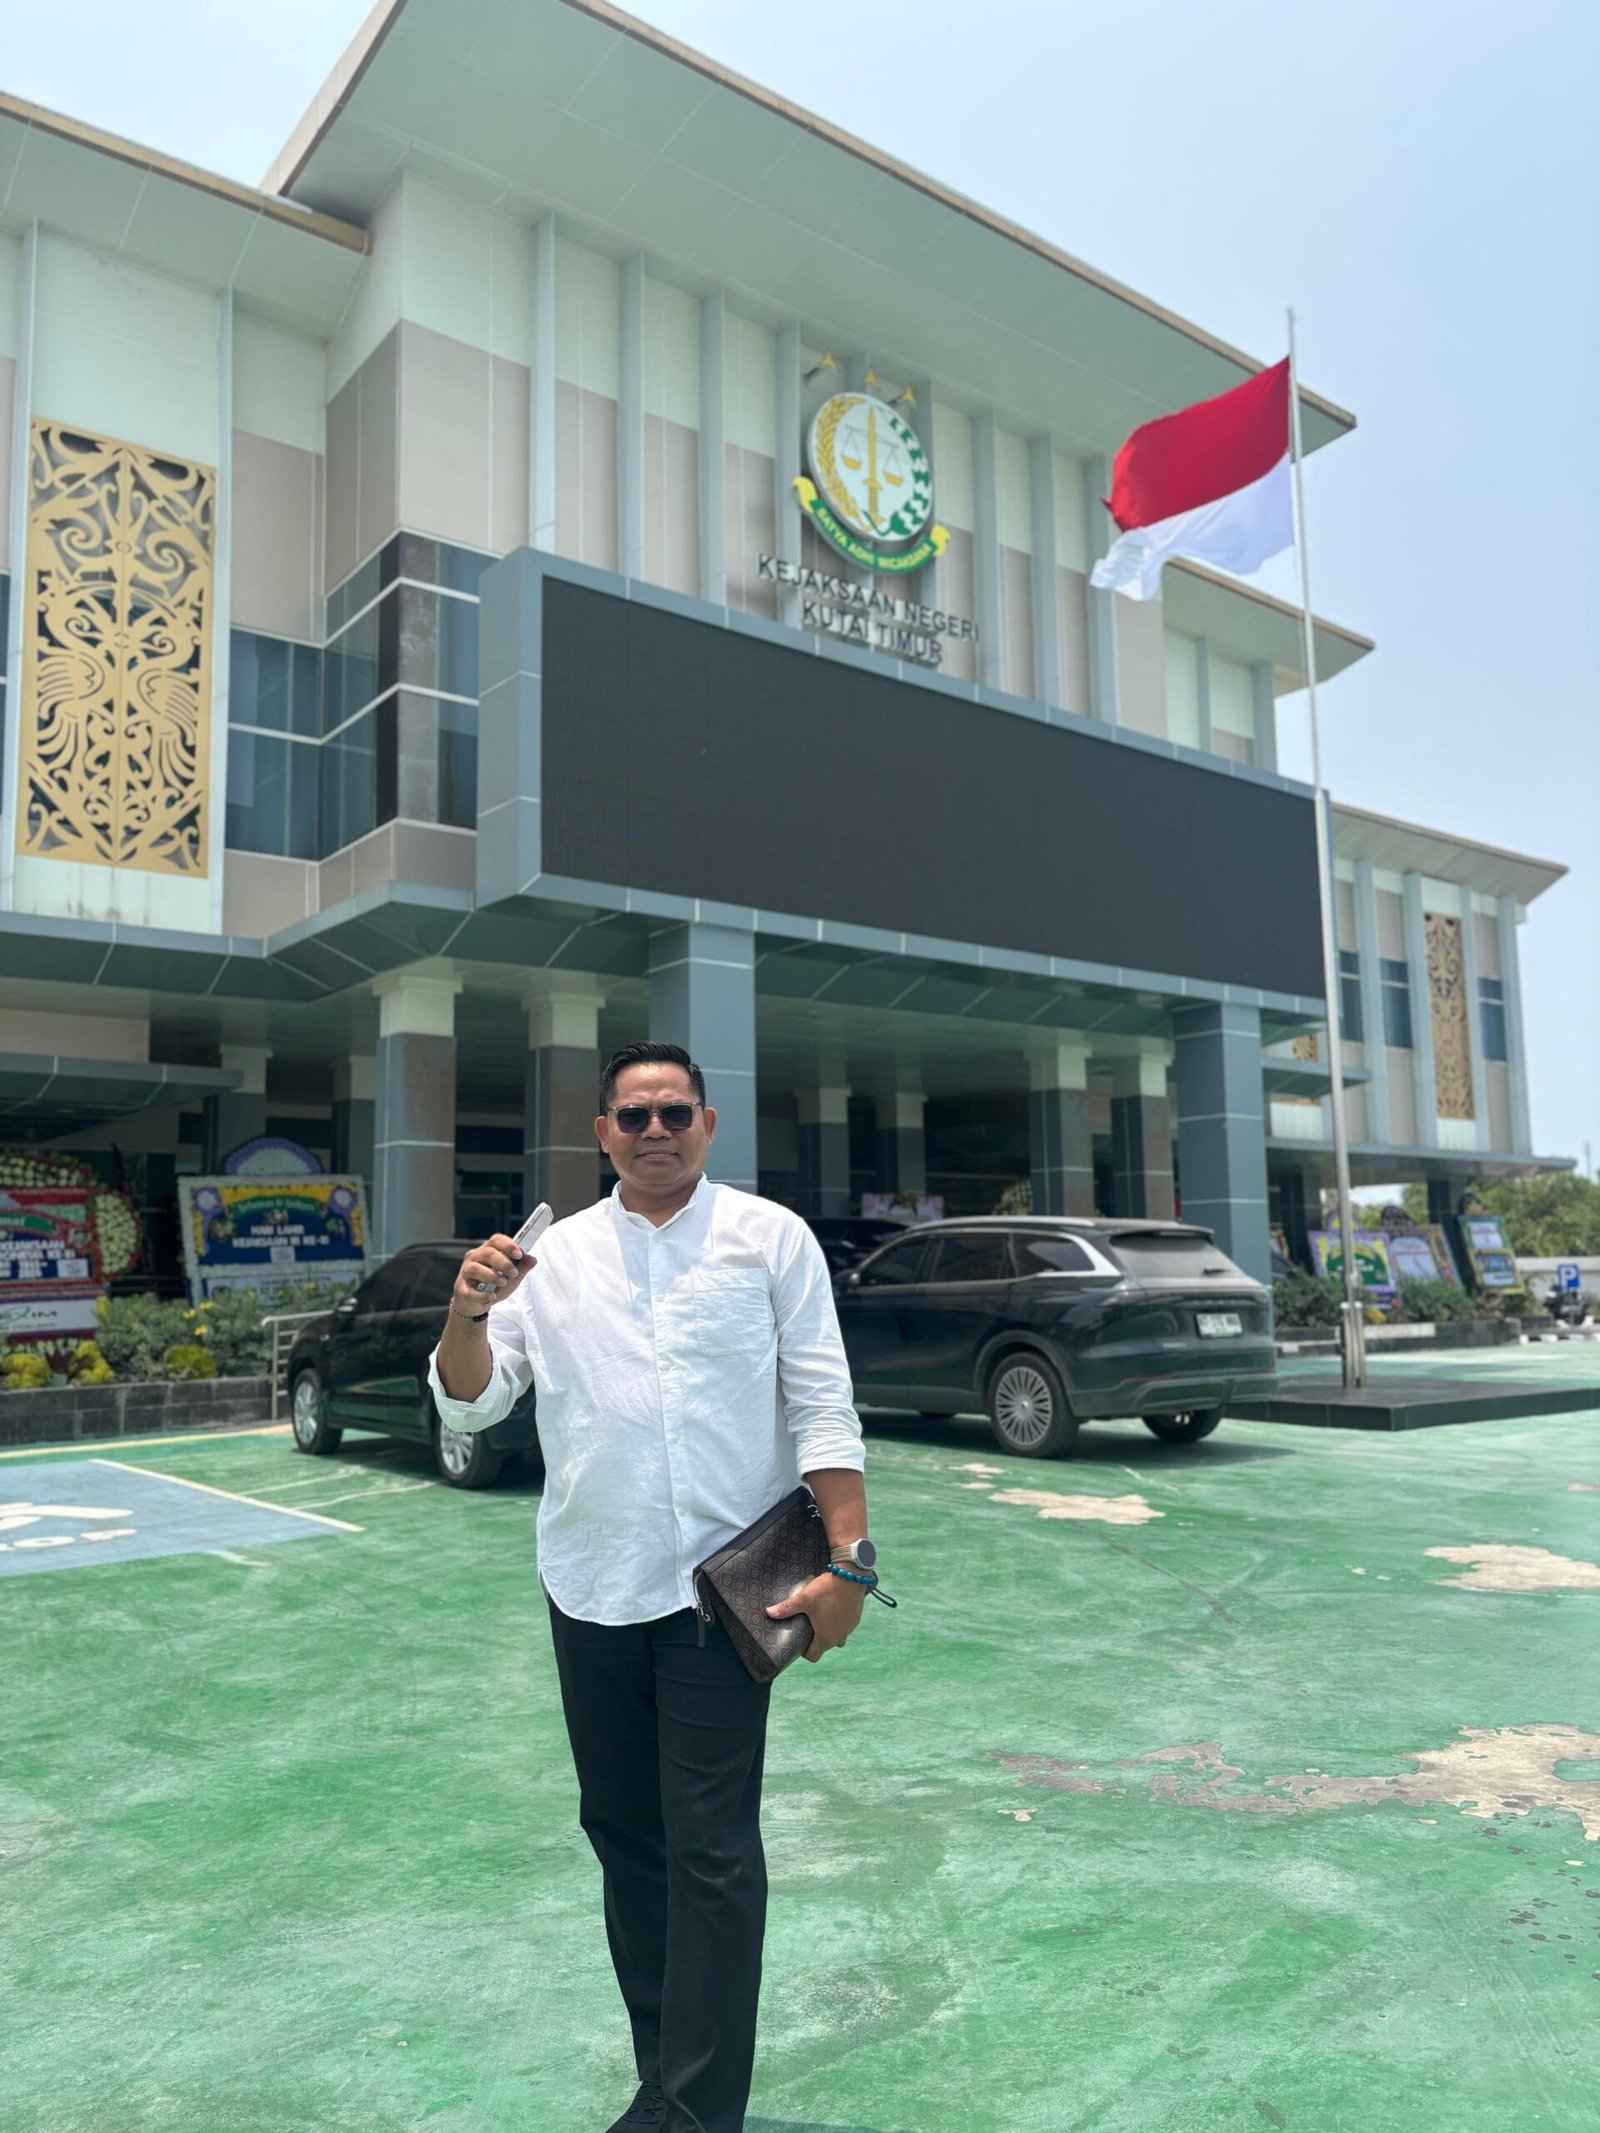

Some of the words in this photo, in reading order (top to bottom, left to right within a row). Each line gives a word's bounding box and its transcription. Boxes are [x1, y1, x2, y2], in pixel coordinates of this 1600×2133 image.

[758, 553, 897, 617] KEJAKSAAN
[904, 601, 980, 642] NEGERI
[803, 599, 870, 638] KUTAI
[877, 624, 943, 664] TIMUR
[1560, 1267, 1578, 1287] P
